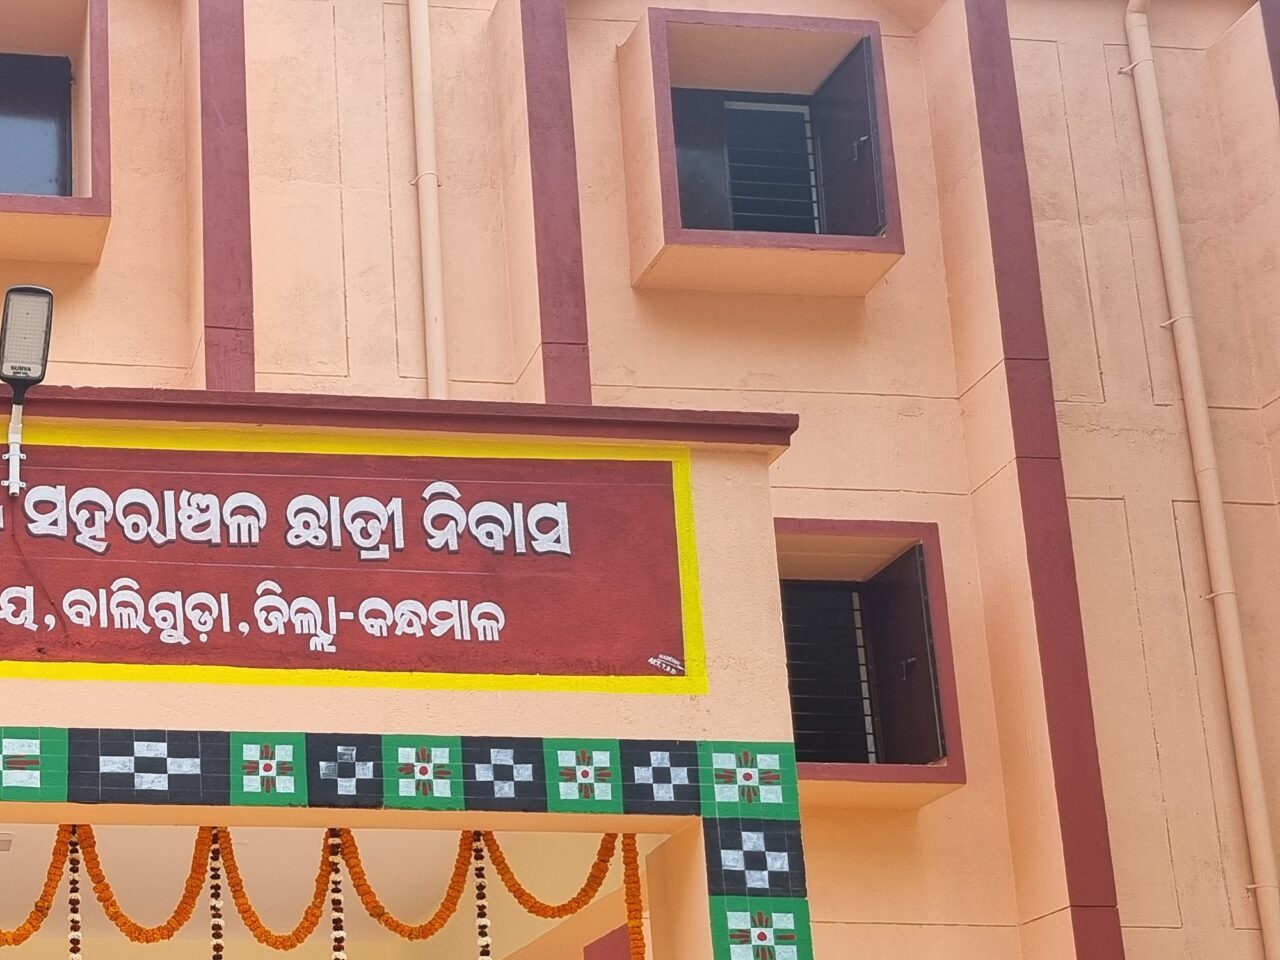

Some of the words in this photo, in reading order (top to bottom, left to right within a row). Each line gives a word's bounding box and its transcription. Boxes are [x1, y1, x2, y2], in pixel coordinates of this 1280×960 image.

[24, 485, 267, 553] ସହରାଞ୍ଚଳ
[286, 494, 405, 559] ଛାତ୍ରୀ
[421, 481, 571, 555] ନିବାସ
